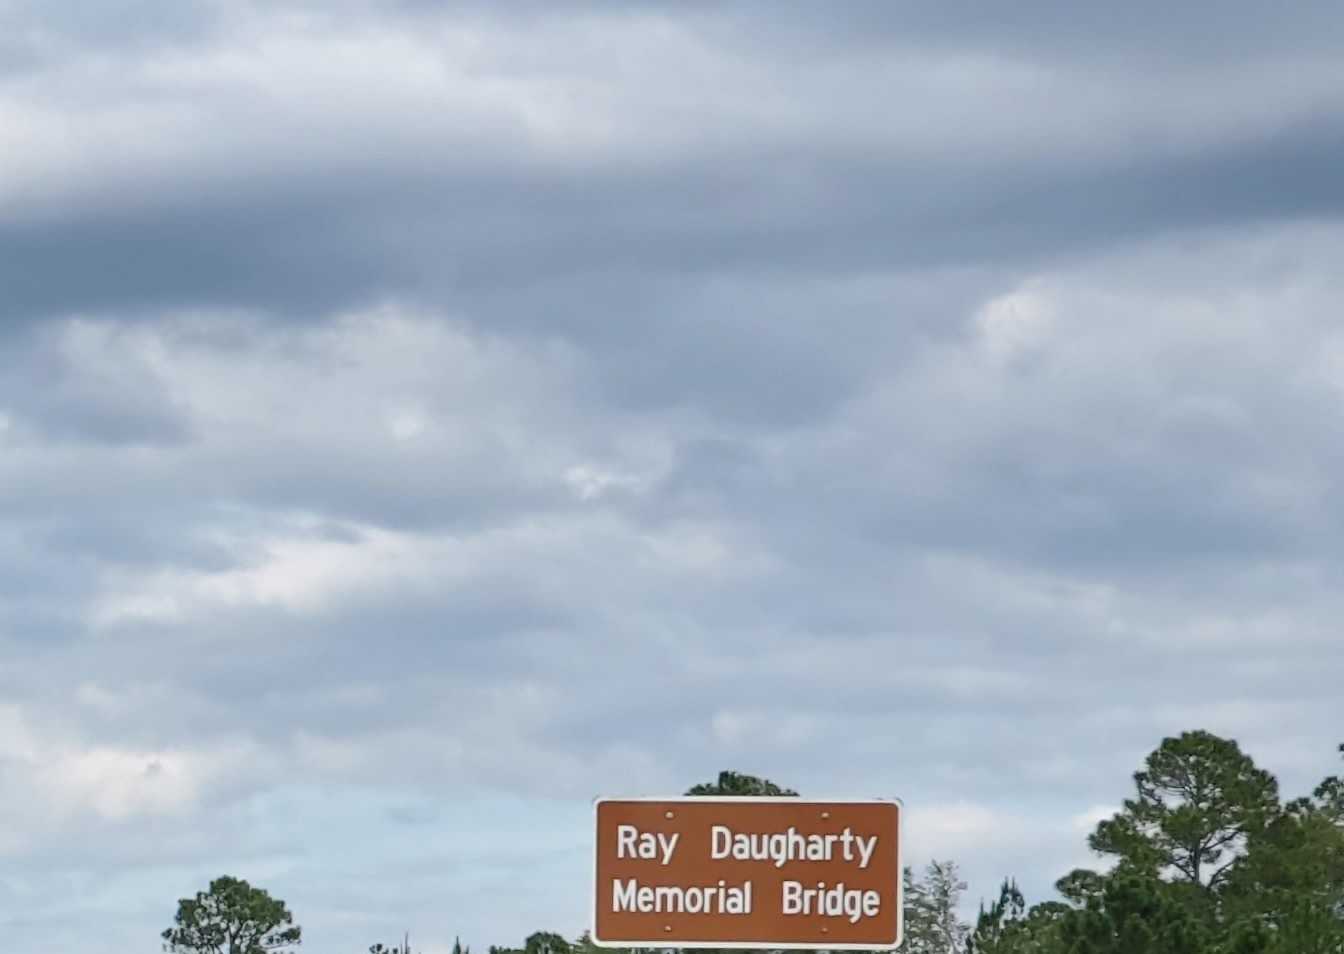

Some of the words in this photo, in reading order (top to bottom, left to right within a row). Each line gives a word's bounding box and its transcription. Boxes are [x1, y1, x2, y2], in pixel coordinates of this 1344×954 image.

[616, 824, 679, 865] Ray
[710, 825, 878, 868] Daugharty
[612, 879, 752, 914] Memorial
[782, 880, 881, 923] Bridge
